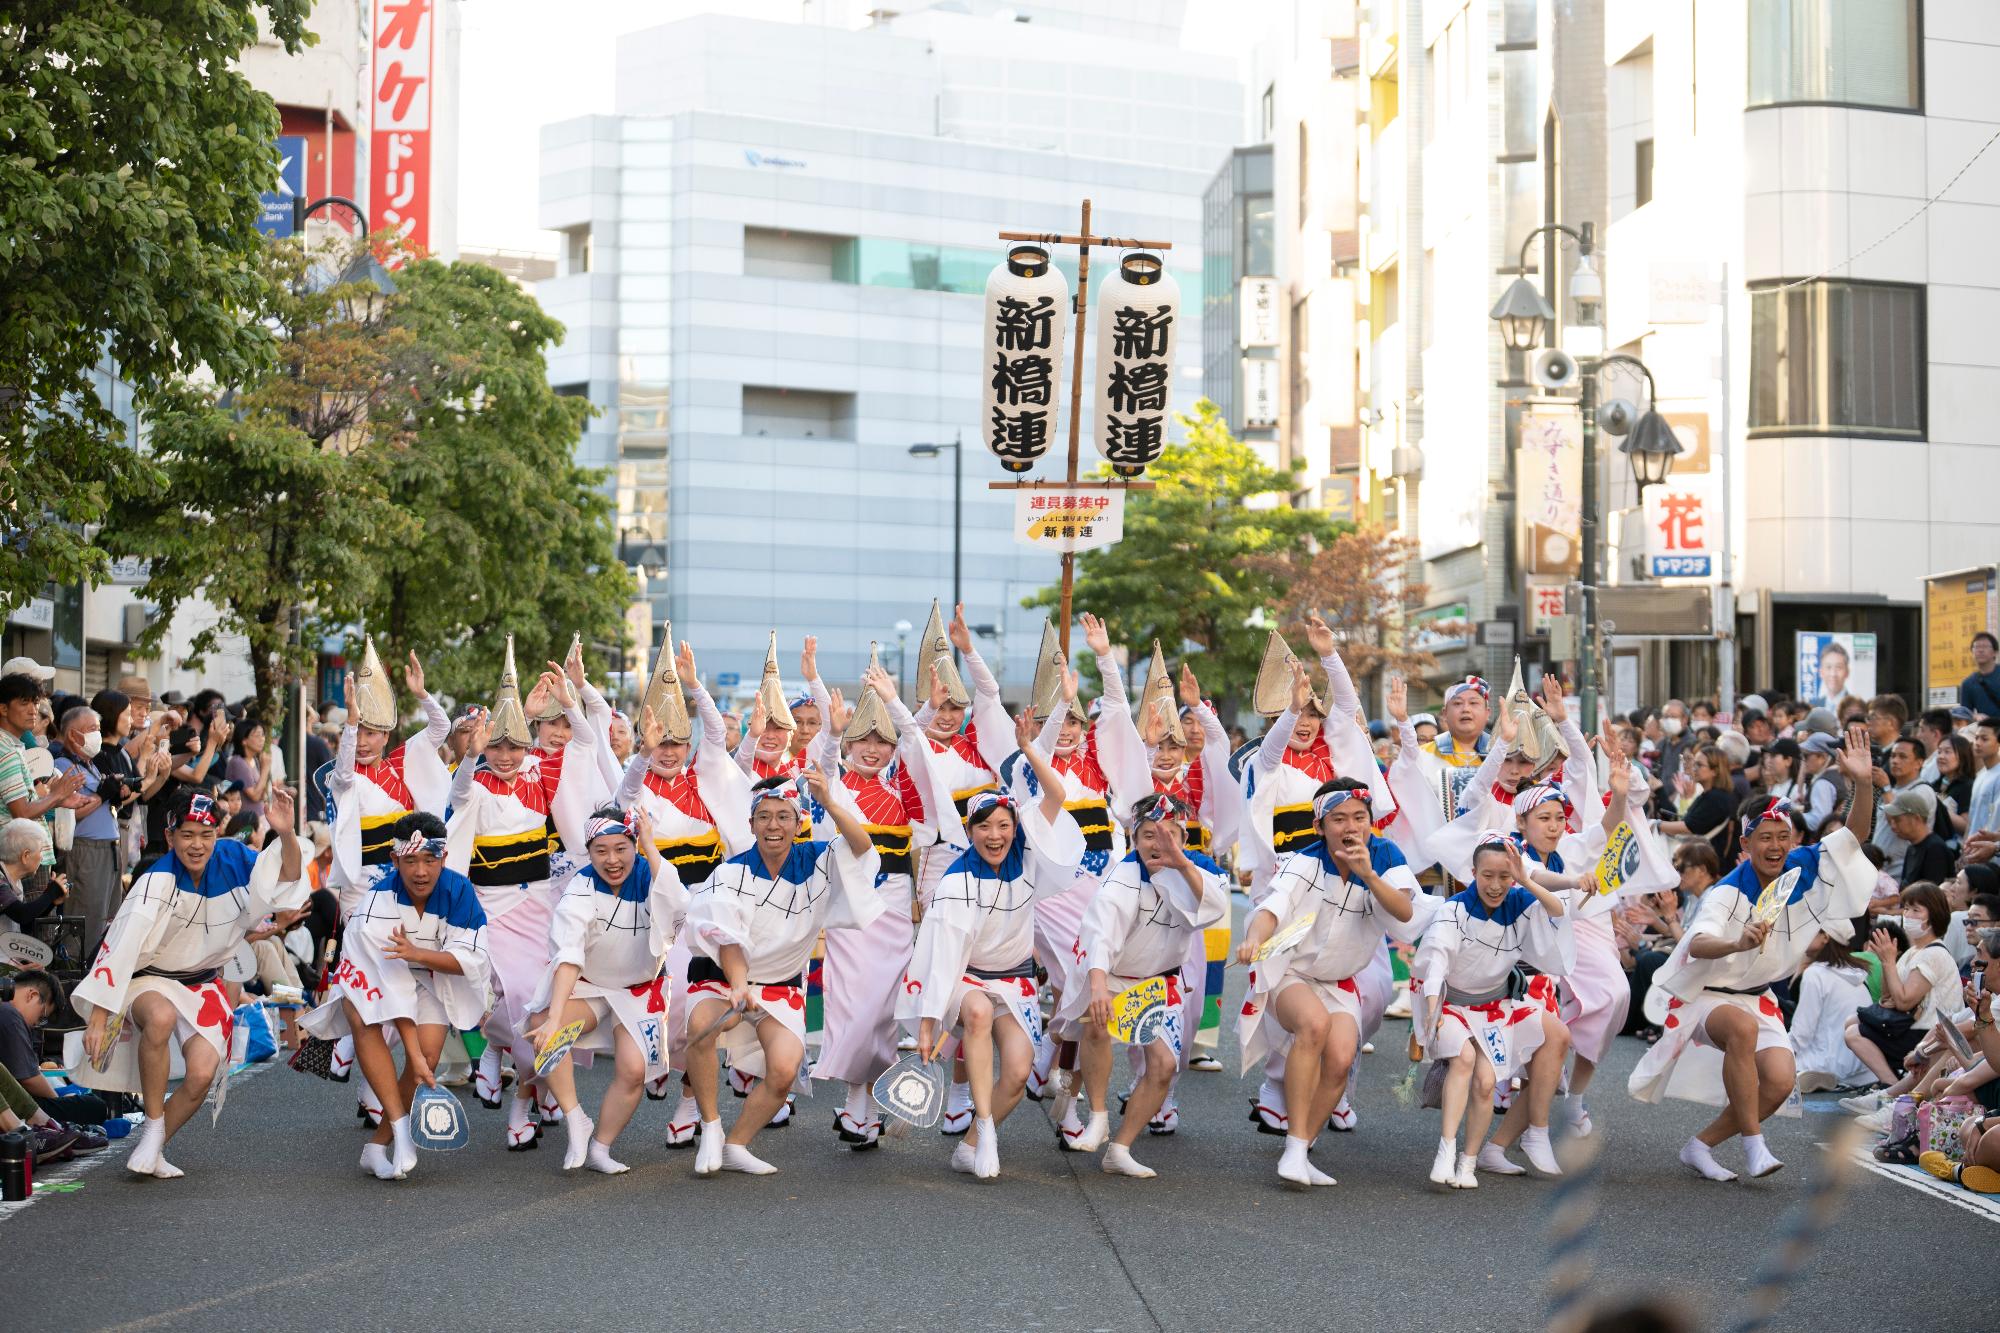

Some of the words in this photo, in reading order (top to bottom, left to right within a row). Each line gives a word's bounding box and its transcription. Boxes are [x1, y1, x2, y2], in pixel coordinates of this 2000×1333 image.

[991, 295, 1056, 458] 新橋連
[1105, 304, 1174, 464] 新橋連
[1544, 421, 1566, 522] みずき通り
[1031, 496, 1110, 510] 連員募集中
[1658, 493, 1704, 550] 花
[1656, 561, 1707, 574] ヤマウチ
[1538, 588, 1565, 617] 花
[9, 942, 44, 960] Orion
